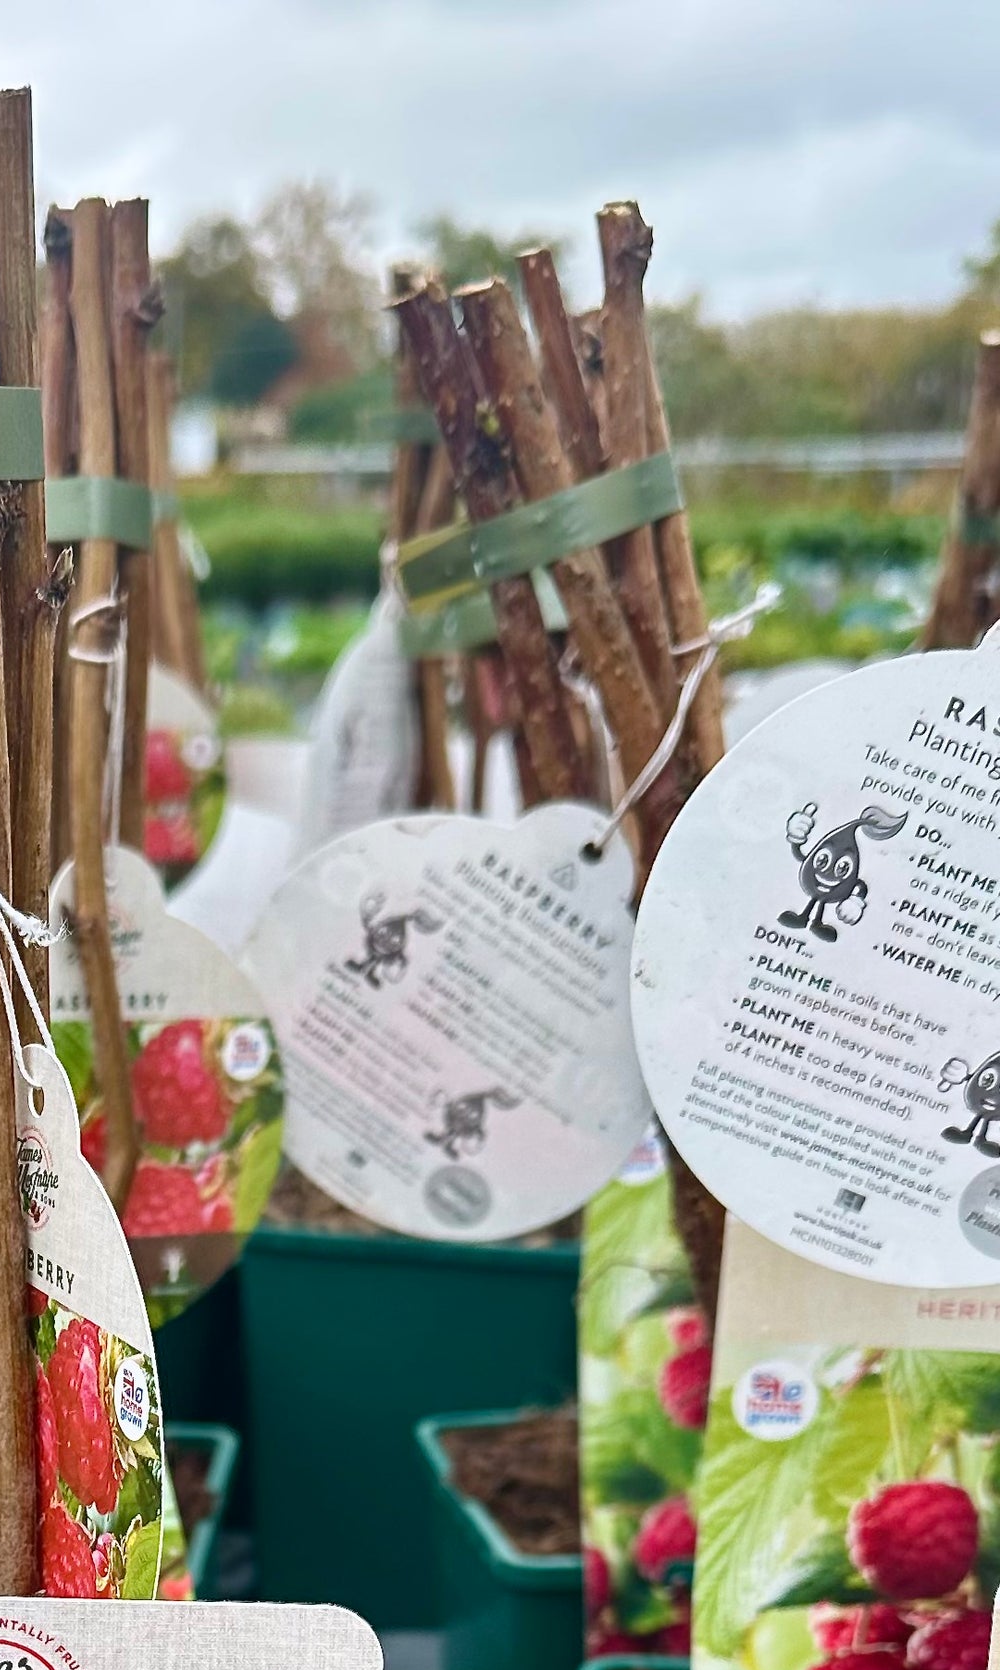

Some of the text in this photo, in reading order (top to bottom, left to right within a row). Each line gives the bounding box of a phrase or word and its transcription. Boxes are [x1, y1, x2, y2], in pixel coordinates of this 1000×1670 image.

[866, 744, 899, 770] Take
[903, 761, 937, 784] care
[941, 775, 962, 790] of
[961, 783, 986, 801] me
[860, 775, 997, 832] provide you with
[915, 824, 952, 849] DO...
[909, 877, 929, 892] on
[931, 887, 940, 896] a
[943, 890, 979, 912] ridge
[981, 900, 996, 915] if
[917, 855, 997, 894] PLANT ME
[891, 921, 914, 937] me
[899, 900, 994, 946] PLANT ME as
[882, 942, 936, 975] WATER
[937, 963, 963, 984] ME
[962, 974, 977, 990] in
[748, 975, 791, 999] grown
[794, 992, 868, 1028] raspberries
[756, 954, 949, 1037] PLANT ME in soils that have
[740, 997, 792, 1026] PLANT
[791, 1015, 816, 1036] ME
[816, 1025, 830, 1042] in
[832, 1030, 872, 1059] heavy
[874, 1046, 901, 1068] wet
[724, 1039, 740, 1053] of
[740, 1045, 751, 1058] 4
[752, 1048, 796, 1076] inches
[797, 1069, 808, 1081] is
[730, 1021, 950, 1114] PLANT ME too deep (a maximum
[691, 1075, 933, 1177] back of the colour label supplied with me or
[697, 1060, 947, 1165] Full planting instructions are provided on the
[679, 1109, 687, 1119] a
[687, 1112, 771, 1150] comprehensive
[770, 1141, 802, 1166] guide
[805, 1156, 822, 1170] on
[823, 1161, 849, 1181] how
[849, 1172, 863, 1188] to
[864, 1176, 891, 1197] look
[891, 1187, 920, 1209] after
[684, 1091, 758, 1128] alternatively
[755, 1118, 779, 1138] visit
[934, 1186, 952, 1202] for
[27, 1248, 75, 1294] BERRY
[121, 1391, 143, 1418] home
